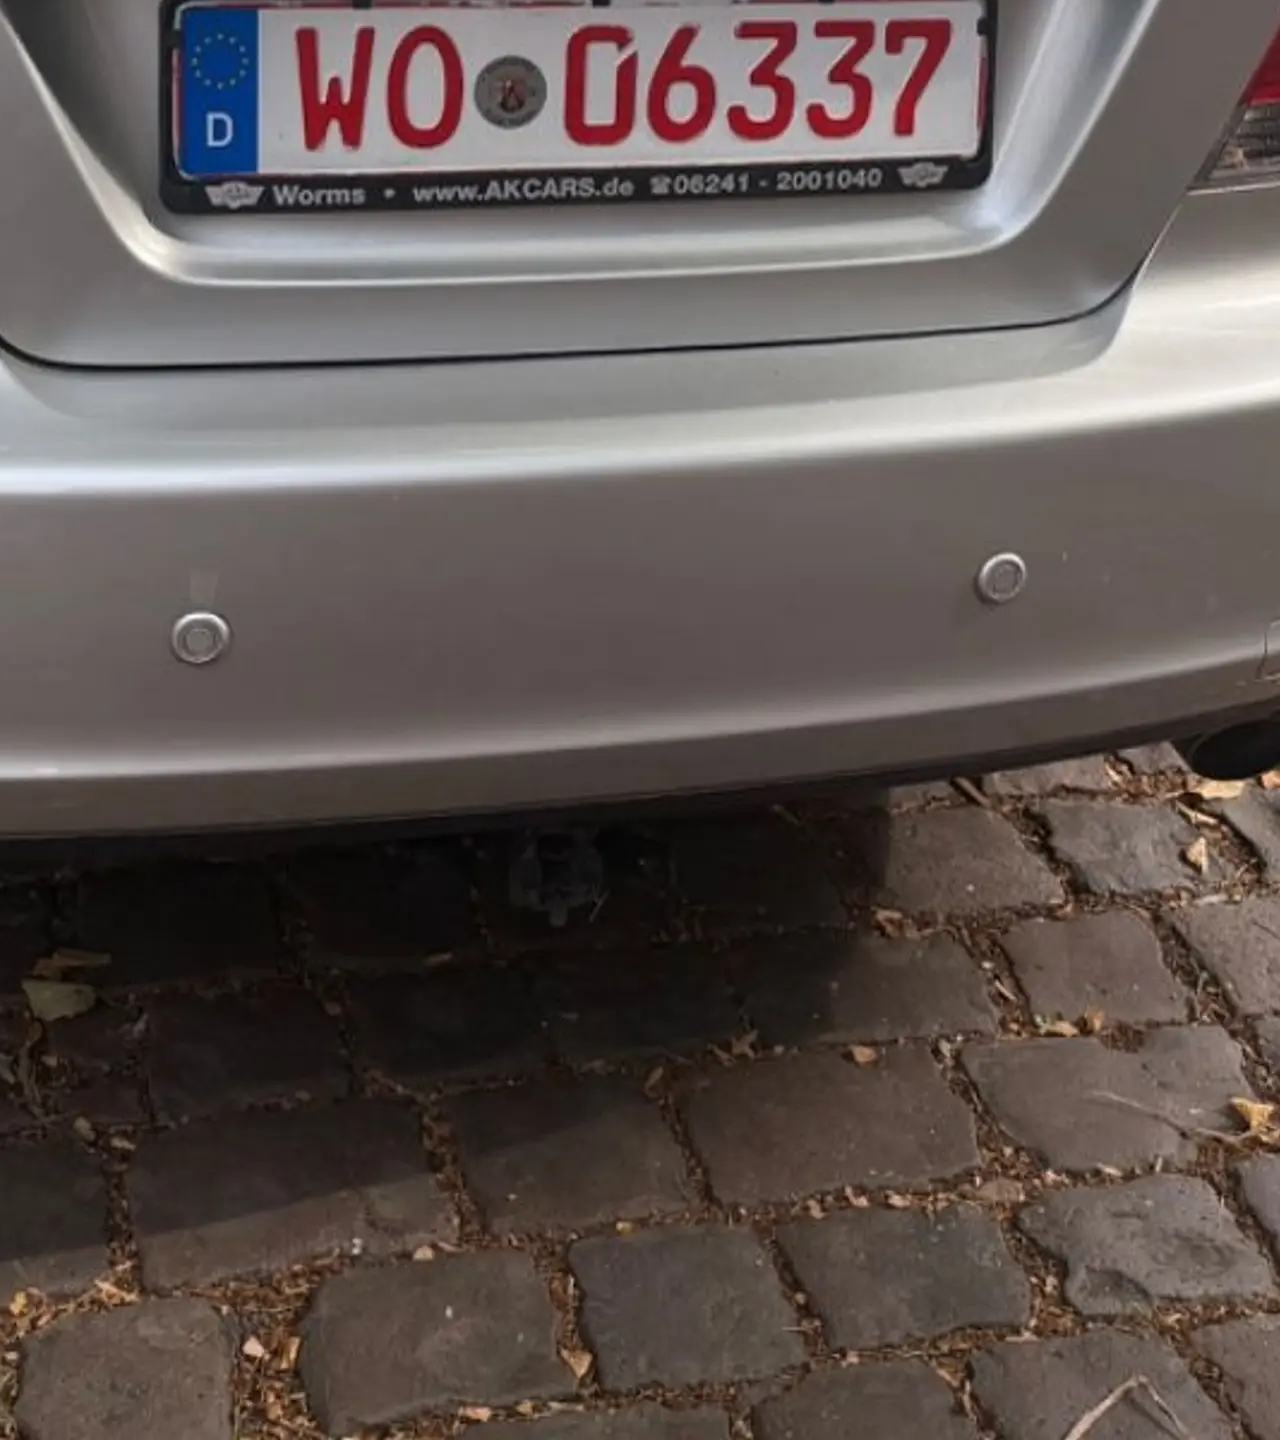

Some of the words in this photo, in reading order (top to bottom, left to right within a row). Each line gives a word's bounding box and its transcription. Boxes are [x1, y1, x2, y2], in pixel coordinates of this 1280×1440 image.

[296, 24, 464, 151] WO
[564, 18, 951, 147] 06337
[206, 112, 234, 148] D
[273, 184, 366, 206] Worms
[412, 176, 635, 203] www.AKCARS.de
[674, 173, 750, 195] 06241
[776, 167, 883, 191] 2001040
